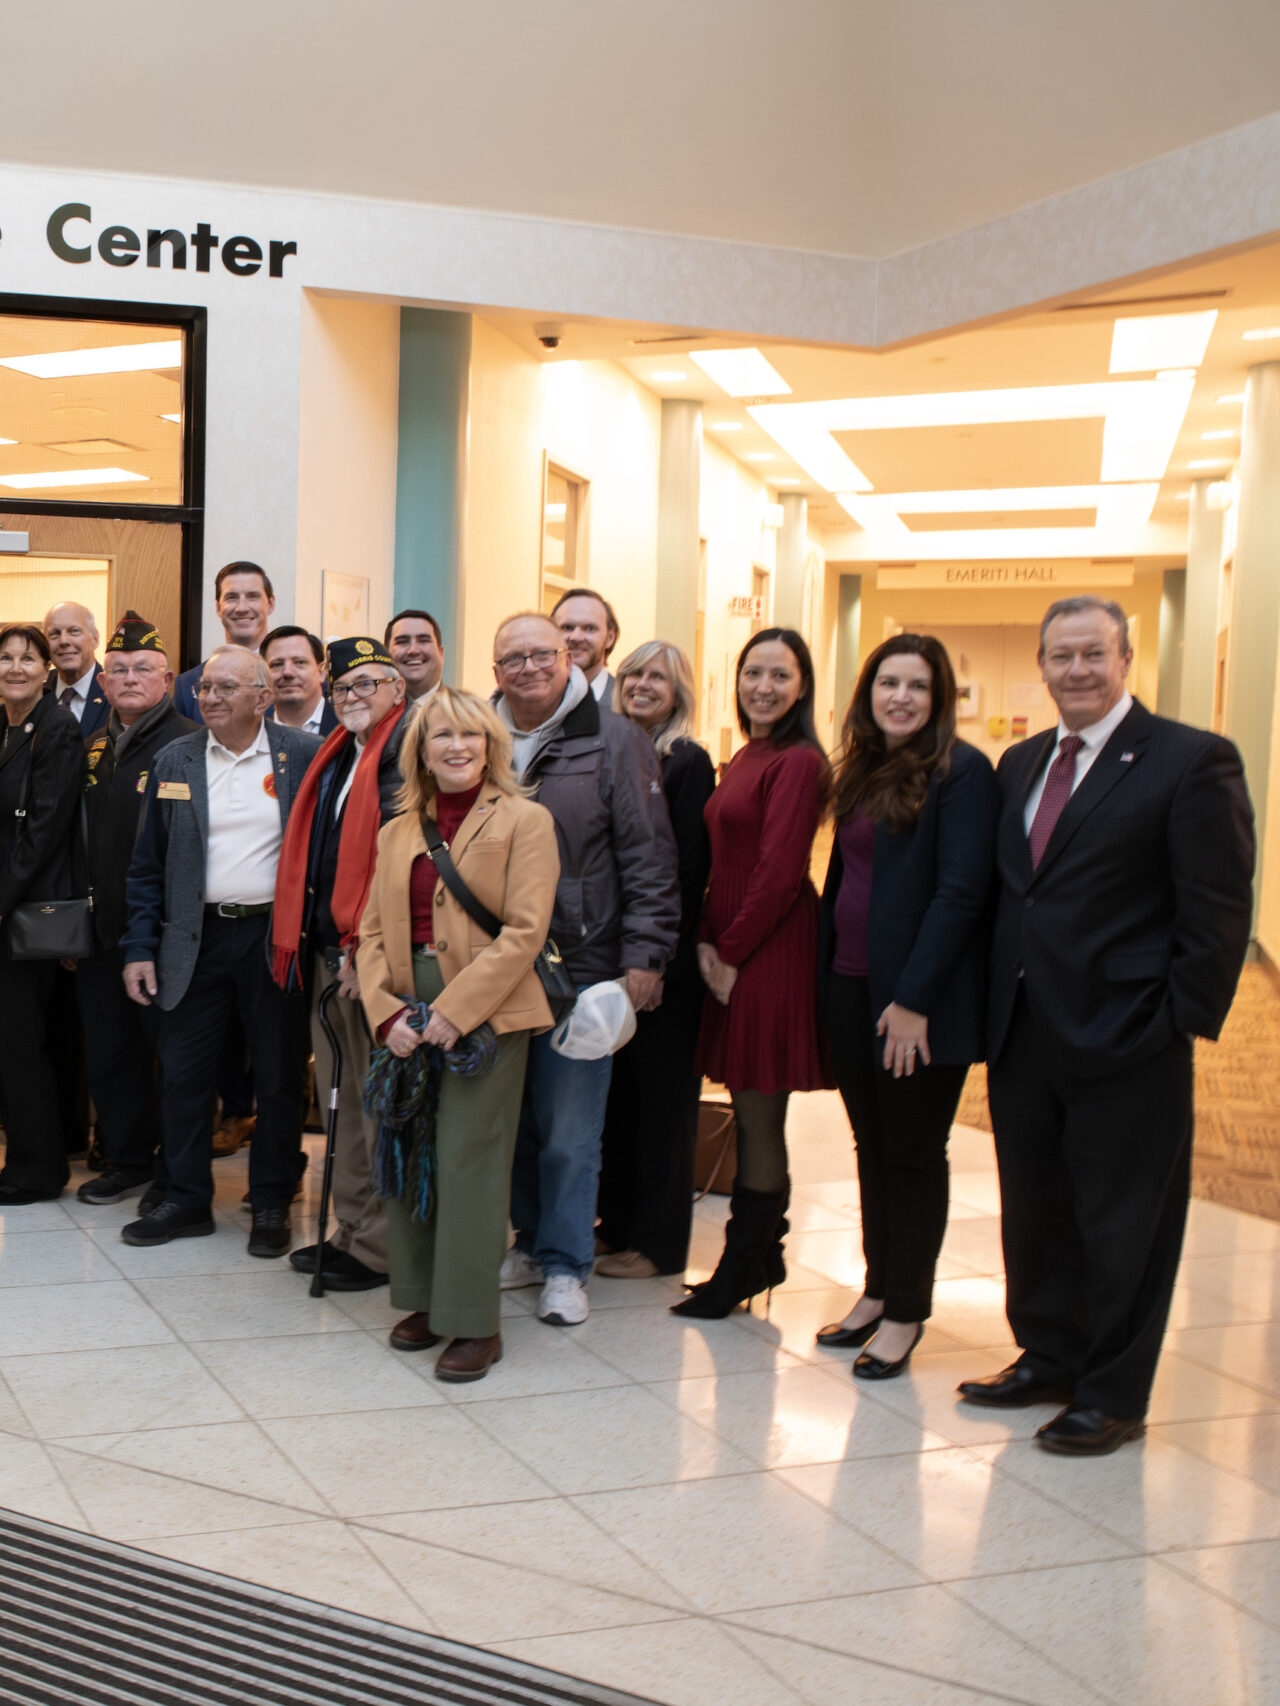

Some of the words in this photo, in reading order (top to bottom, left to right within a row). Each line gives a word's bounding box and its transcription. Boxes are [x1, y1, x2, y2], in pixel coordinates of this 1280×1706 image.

[46, 203, 297, 278] Center
[945, 567, 1008, 583] EMERITI
[1014, 566, 1056, 582] HALL
[731, 596, 754, 611] FIRE
[347, 655, 374, 668] MORRIS
